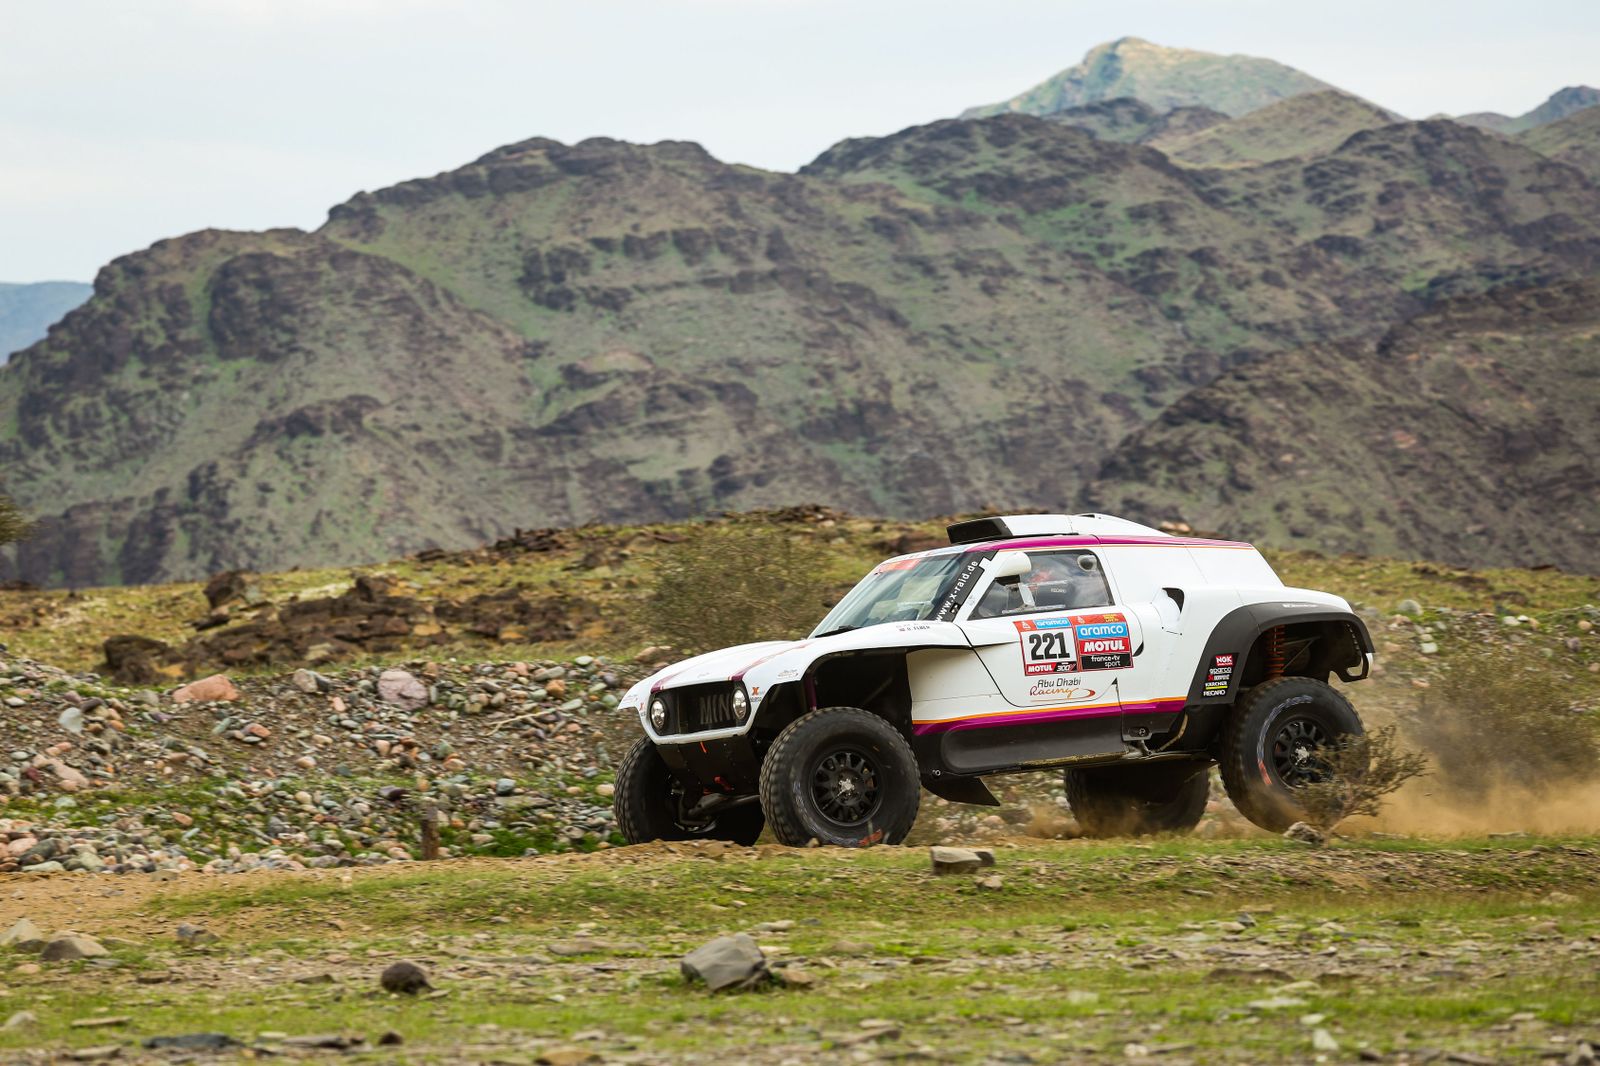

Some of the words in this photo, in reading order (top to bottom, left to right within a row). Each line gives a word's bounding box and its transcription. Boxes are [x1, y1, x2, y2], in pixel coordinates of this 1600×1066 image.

[1037, 619, 1068, 627] aramco
[1080, 625, 1124, 636] aramco
[1028, 632, 1070, 660] 221
[1084, 640, 1125, 652] MOTUL
[1038, 679, 1055, 688] Abu
[1056, 677, 1081, 687] Dhabi
[1030, 686, 1079, 698] Racing
